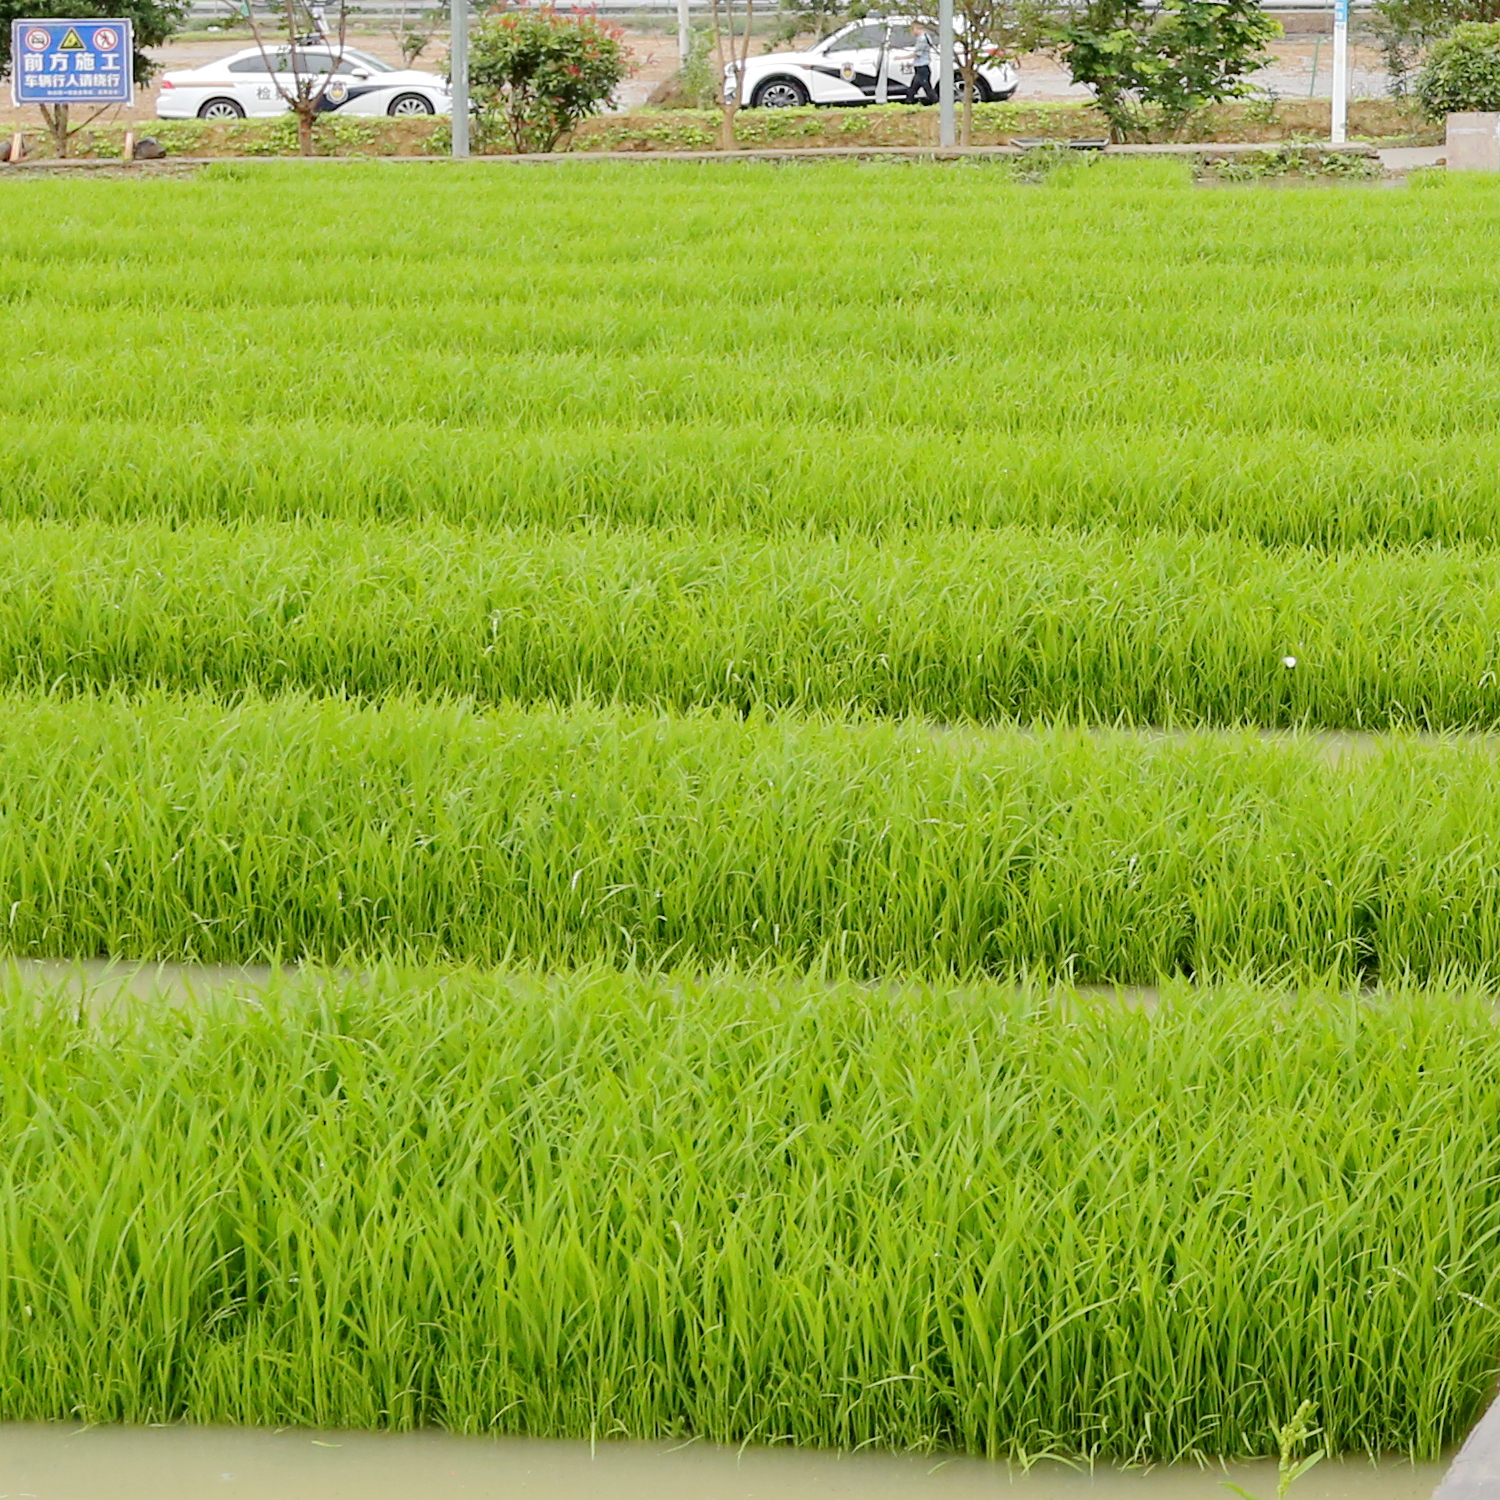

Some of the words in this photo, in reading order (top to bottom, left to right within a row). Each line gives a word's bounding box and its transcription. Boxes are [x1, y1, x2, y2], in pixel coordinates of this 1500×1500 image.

[23, 52, 121, 72] 前方施工
[24, 74, 121, 88] 车辆行人请绕行
